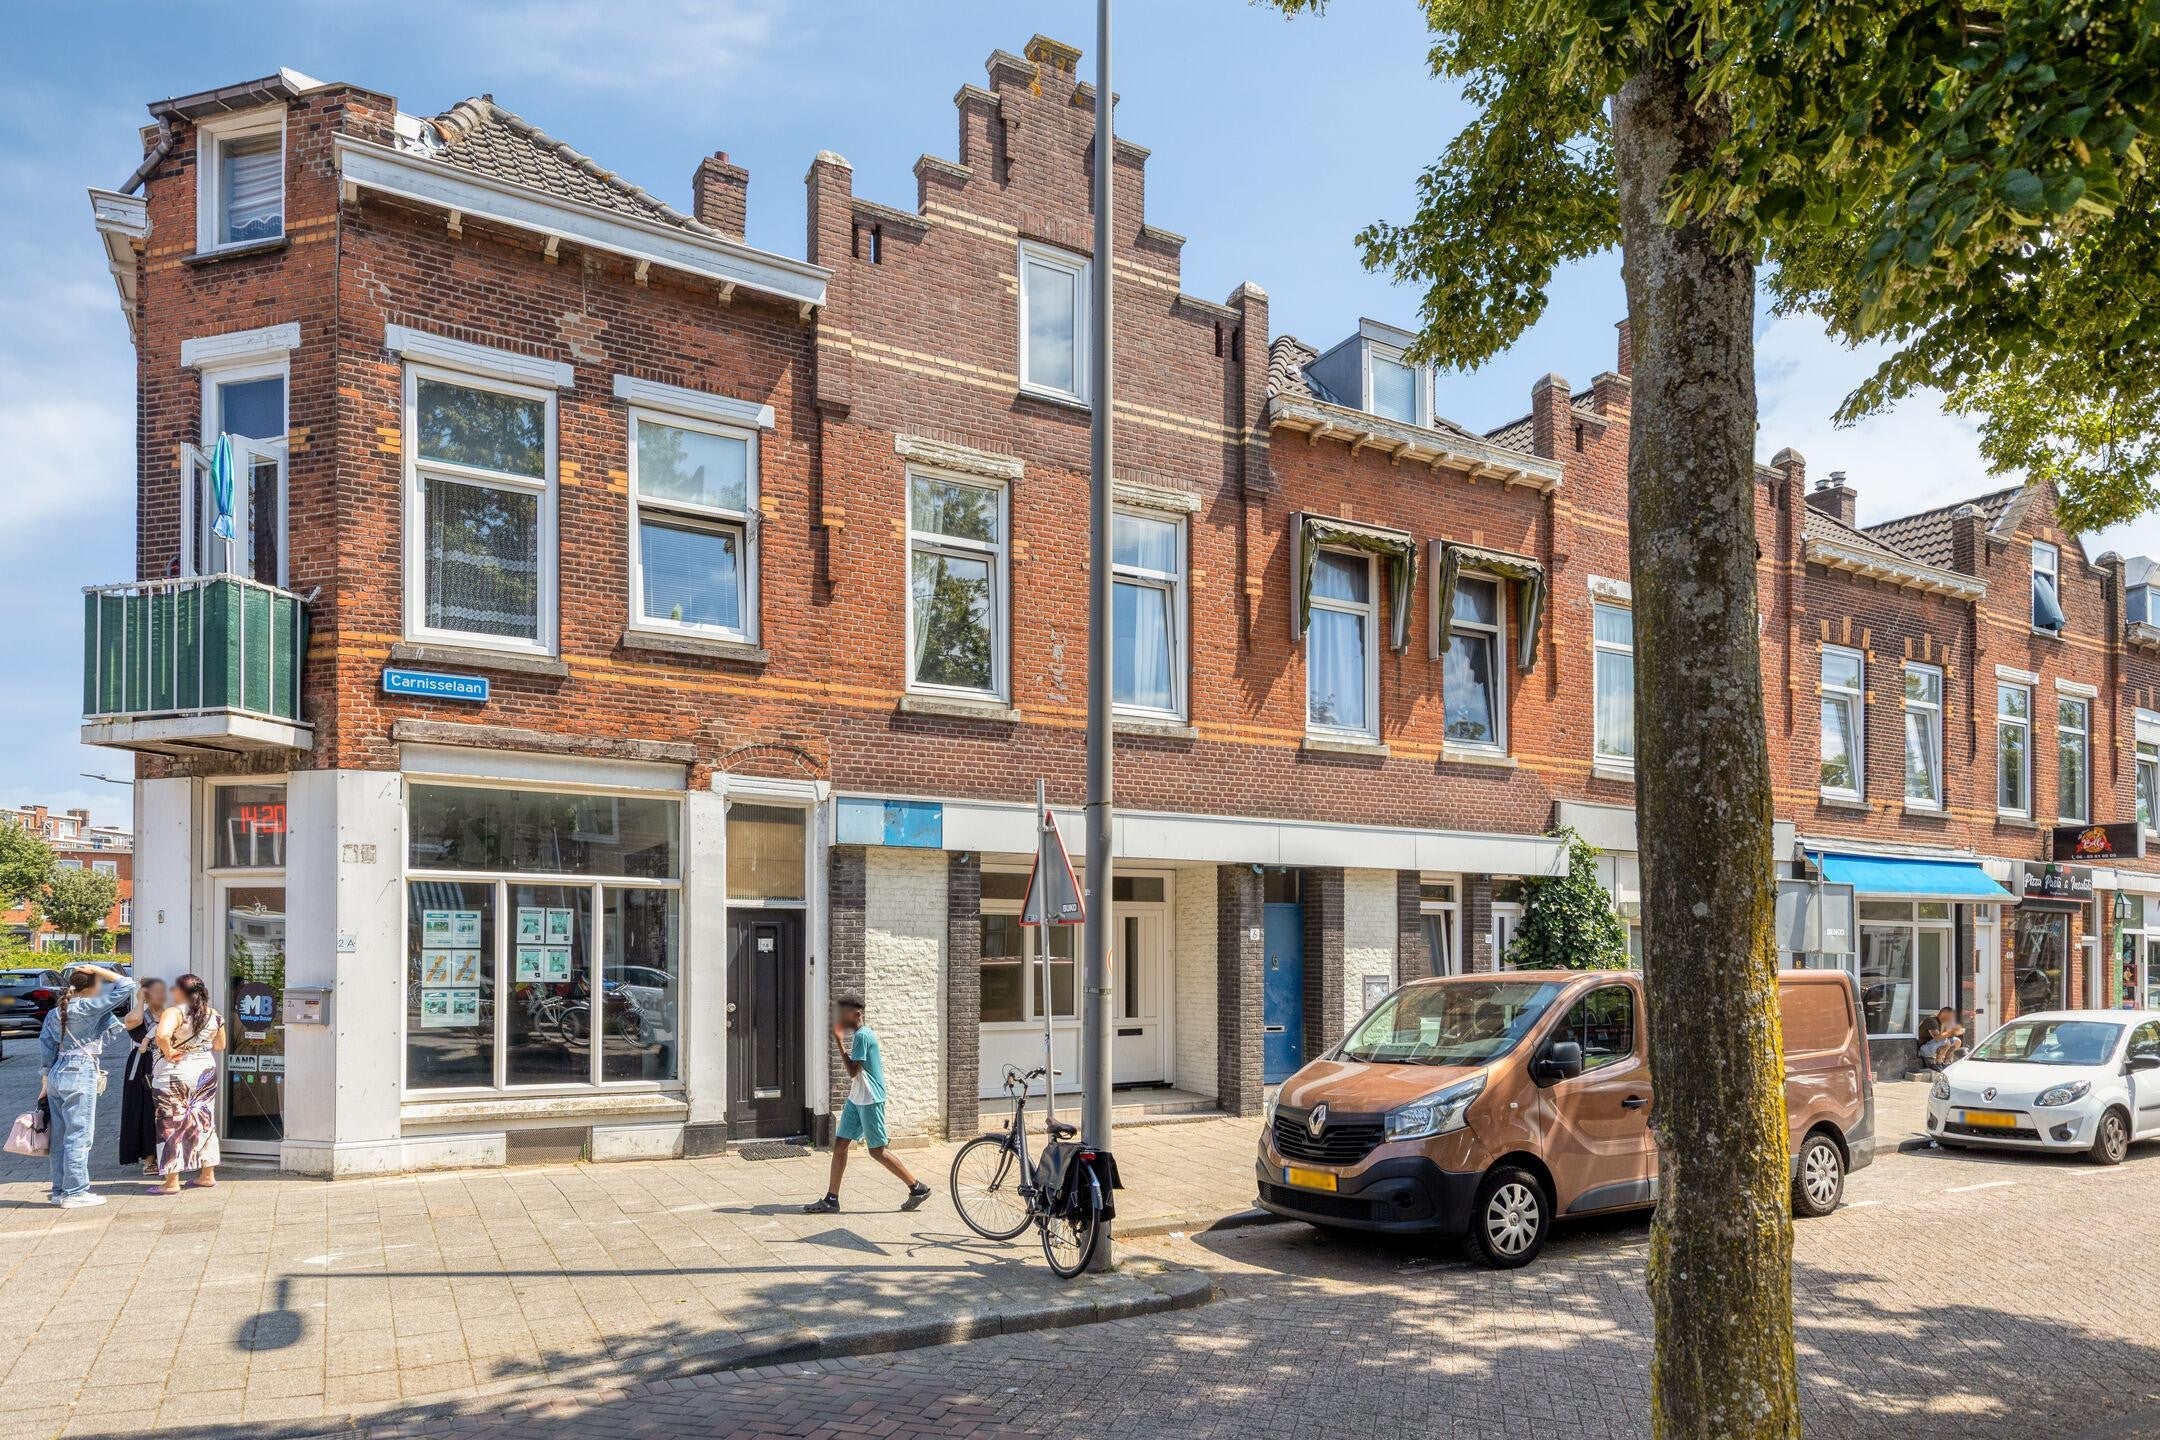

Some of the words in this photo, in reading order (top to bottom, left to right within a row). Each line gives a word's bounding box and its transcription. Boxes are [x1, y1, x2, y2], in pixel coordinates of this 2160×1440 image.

[391, 673, 482, 694] Carnisselaan
[2082, 837, 2105, 849] Billy
[2024, 873, 2042, 888] Pizza
[2044, 874, 2062, 889] Pasta
[2064, 879, 2068, 889] &
[255, 902, 268, 913] 2a
[1062, 903, 1078, 913] BUKO
[239, 994, 273, 1015] MB
